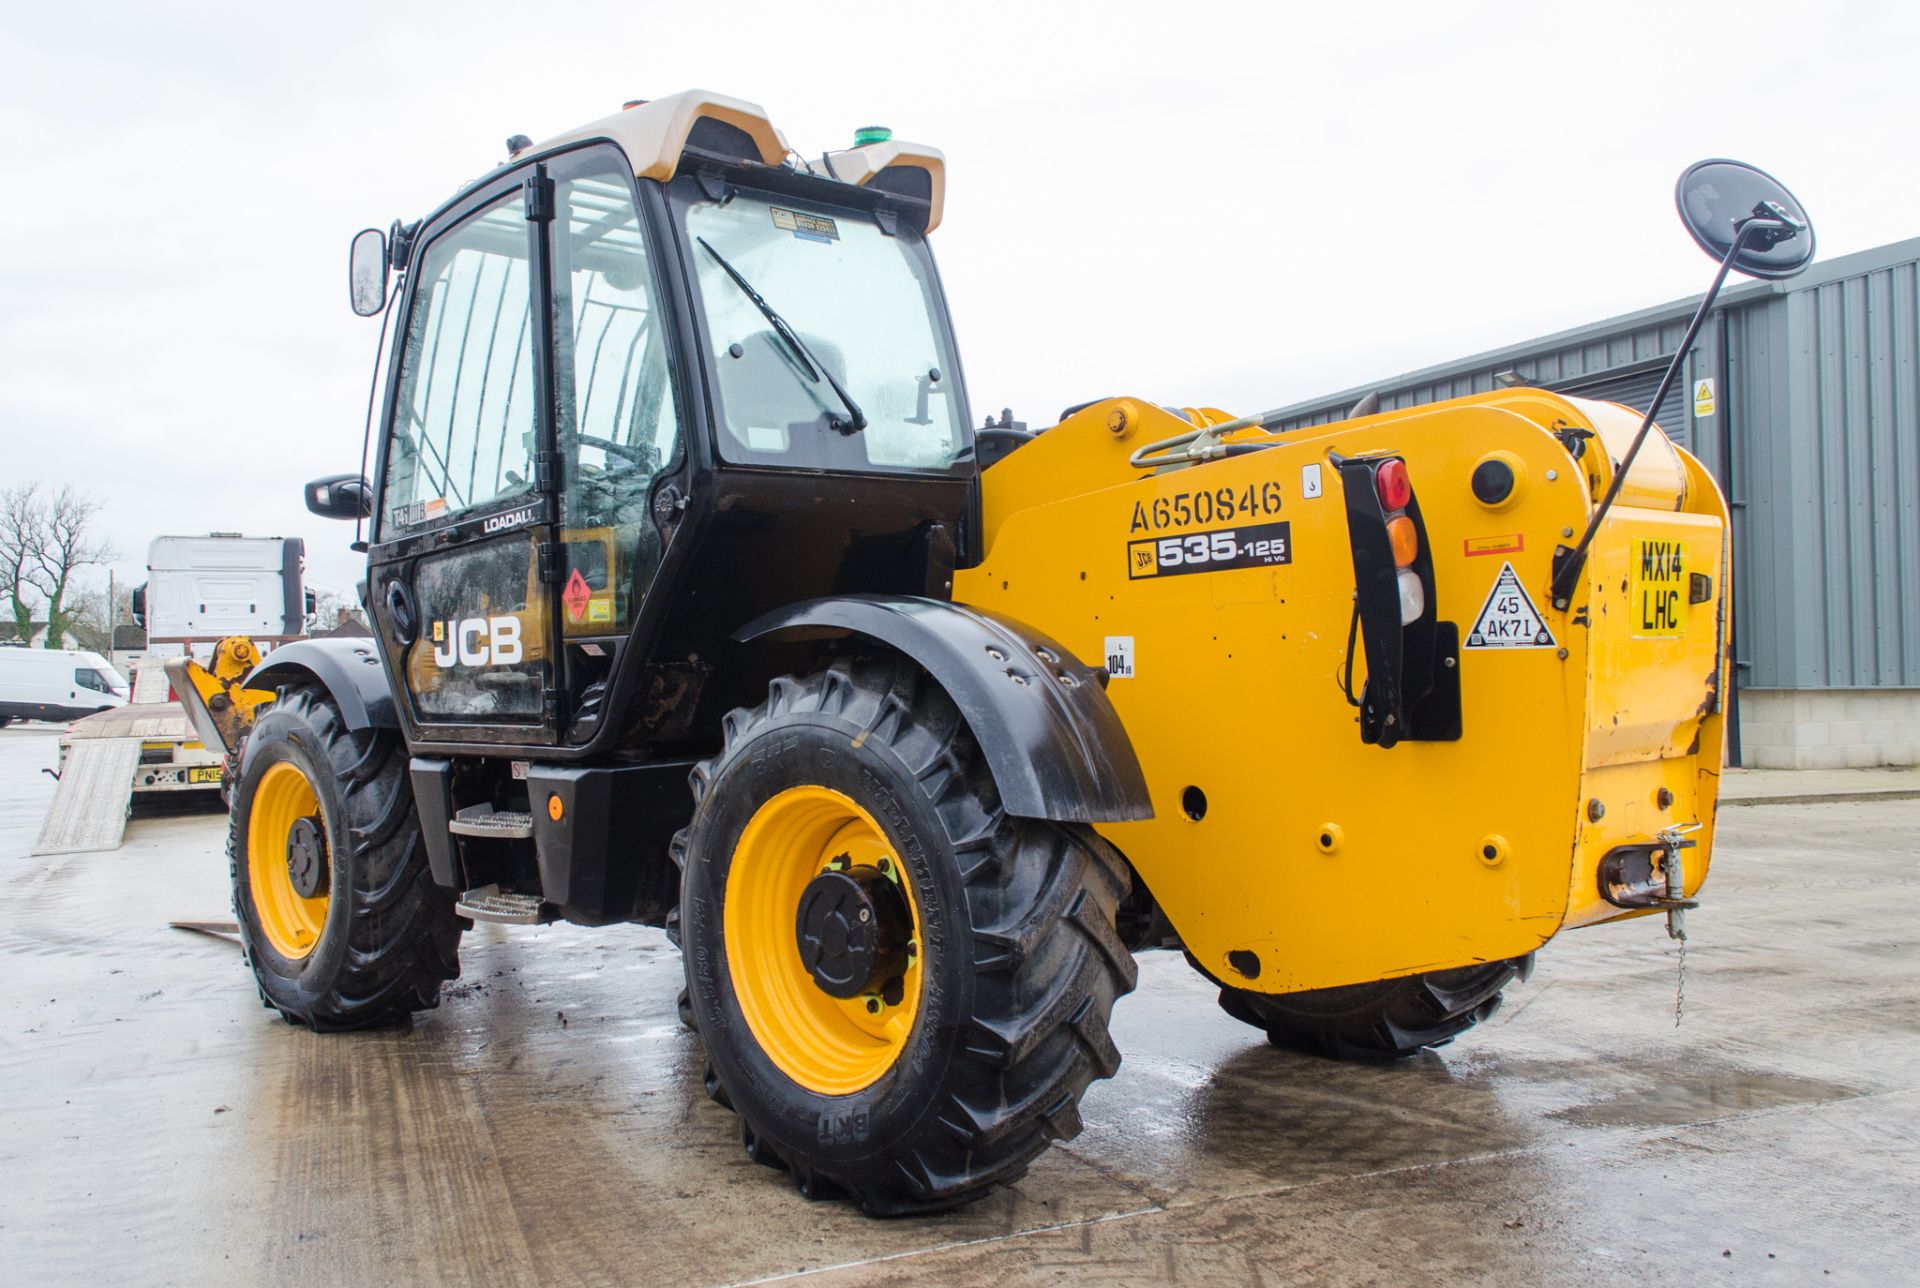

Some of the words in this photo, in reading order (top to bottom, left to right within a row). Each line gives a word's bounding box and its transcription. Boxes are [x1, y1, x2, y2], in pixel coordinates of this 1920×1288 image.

[1642, 541, 1682, 581] MX14
[1497, 596, 1519, 614] 45
[1642, 590, 1679, 629] LHC
[434, 615, 523, 667] JCB
[1108, 654, 1124, 674] 104
[819, 1112, 869, 1140] BKT
